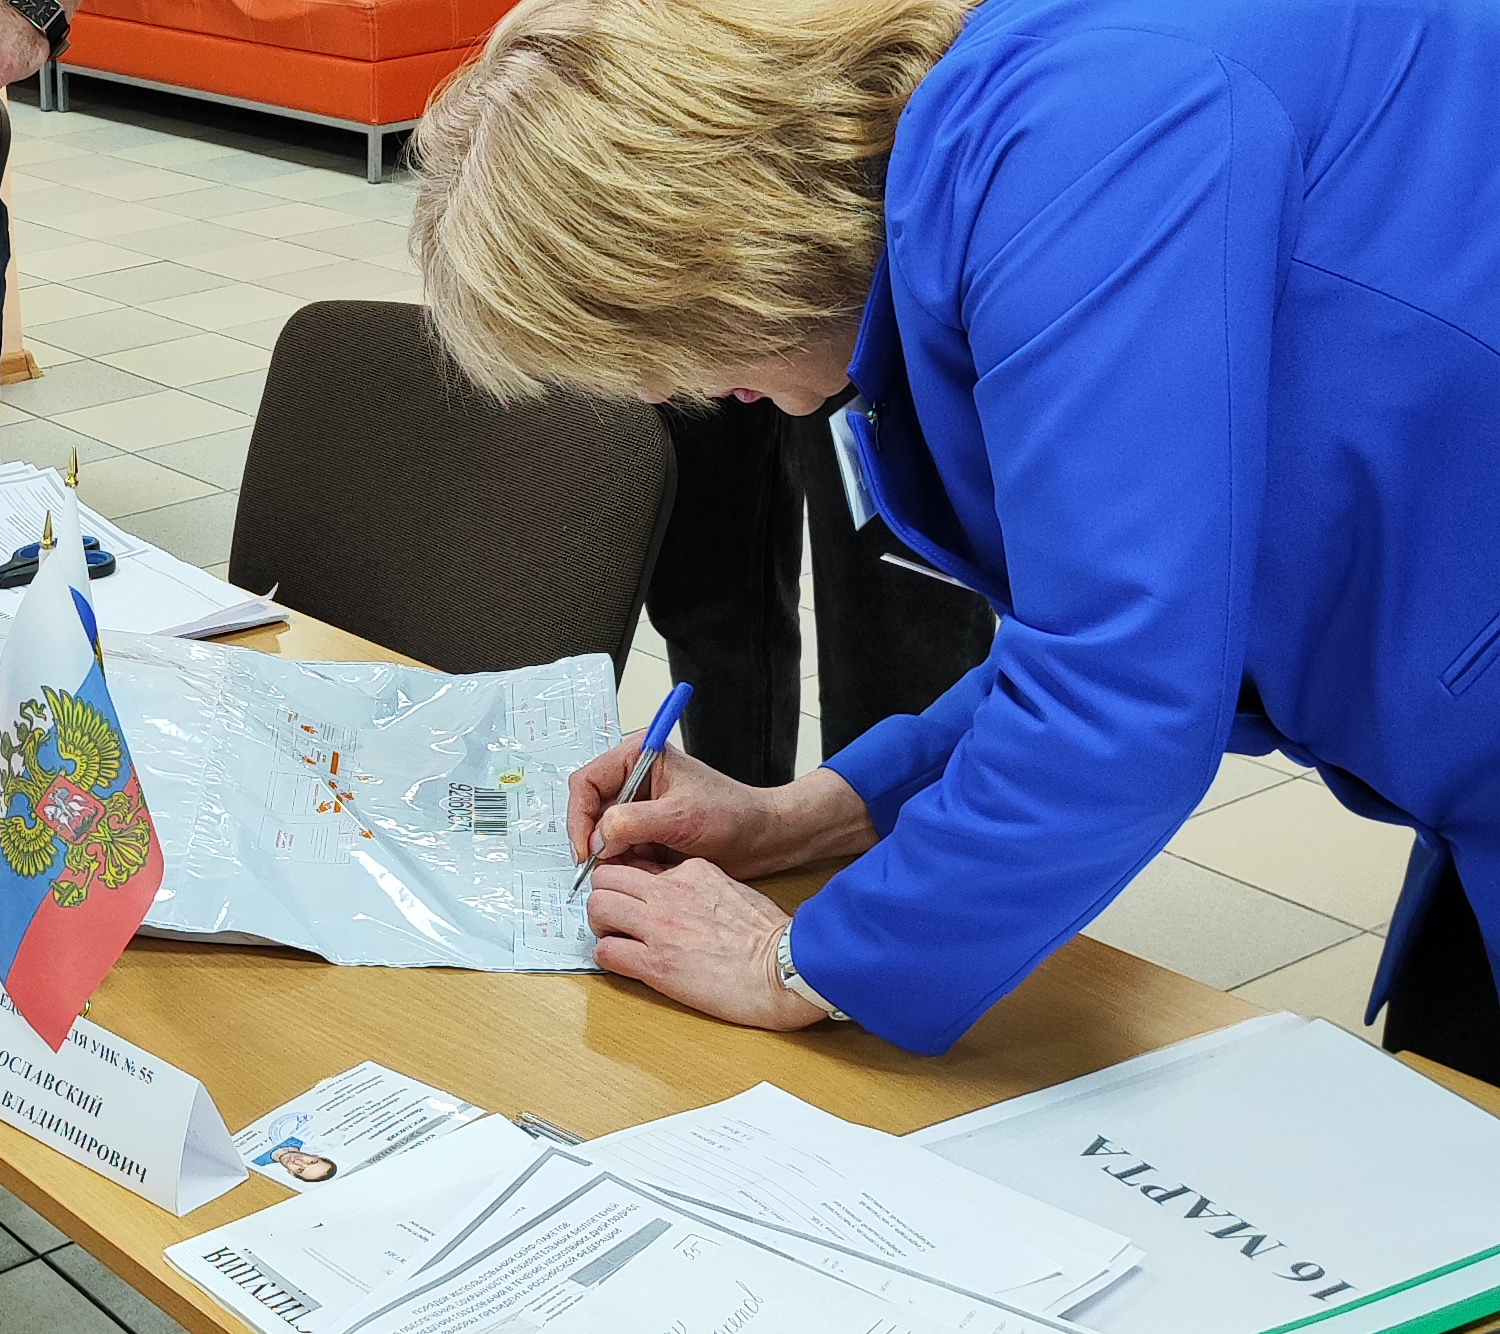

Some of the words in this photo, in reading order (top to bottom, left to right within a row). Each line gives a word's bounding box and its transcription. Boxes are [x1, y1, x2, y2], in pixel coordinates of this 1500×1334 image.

[88, 1040, 121, 1067] УИК
[118, 1056, 140, 1077] №
[135, 1066, 156, 1086] 55
[1078, 1133, 1288, 1261] МАРТА
[1274, 1258, 1360, 1303] 16
